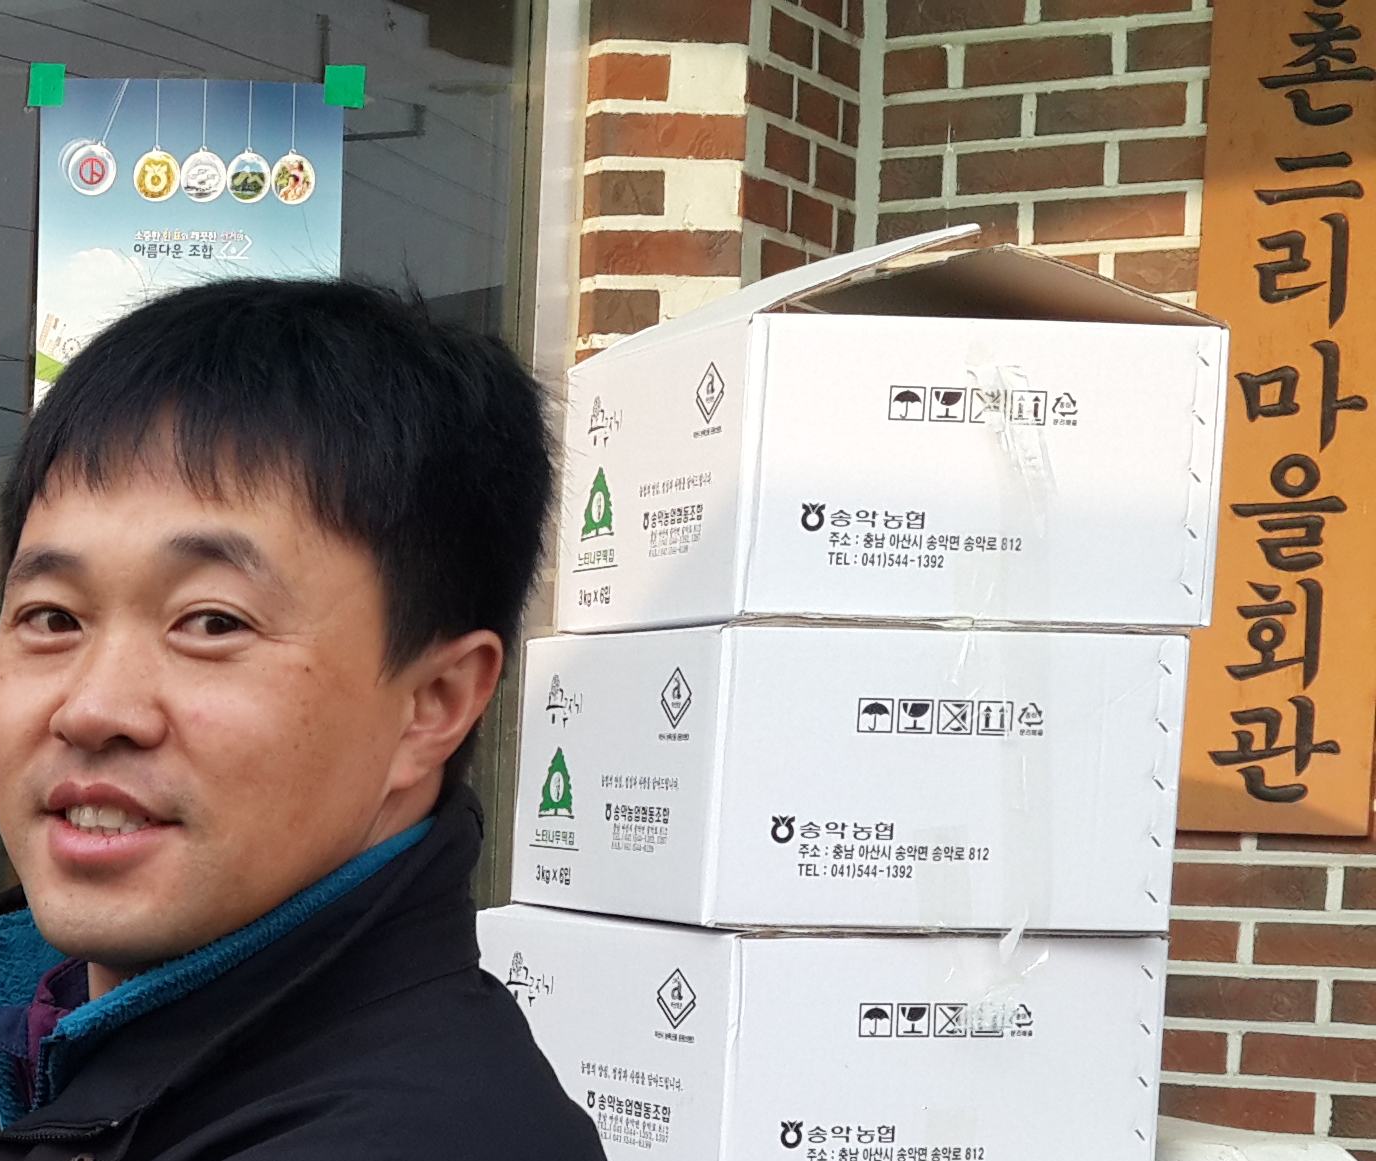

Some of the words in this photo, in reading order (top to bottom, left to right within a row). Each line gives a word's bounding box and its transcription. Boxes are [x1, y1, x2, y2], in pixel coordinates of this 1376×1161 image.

[133, 243, 184, 259] 아름다운
[188, 244, 214, 259] 조합
[830, 509, 926, 530] 송악농협
[862, 533, 886, 549] 충남
[889, 534, 923, 550] 아산시
[926, 535, 961, 551] 송악면
[963, 536, 998, 552] 송악로
[1000, 537, 1023, 552] 812
[861, 552, 945, 569] 041)544-1392
[799, 821, 895, 841] 송악농협
[832, 843, 855, 860] 충남
[858, 844, 892, 861] 아산시
[894, 845, 929, 861] 송악면
[931, 846, 965, 862] 송악로
[968, 847, 990, 861] 812
[830, 864, 914, 880] 041)544-1392
[597, 1093, 671, 1123] 송악농업협동조합
[807, 1125, 896, 1144] 송악농협
[964, 1146, 985, 1161] 812
